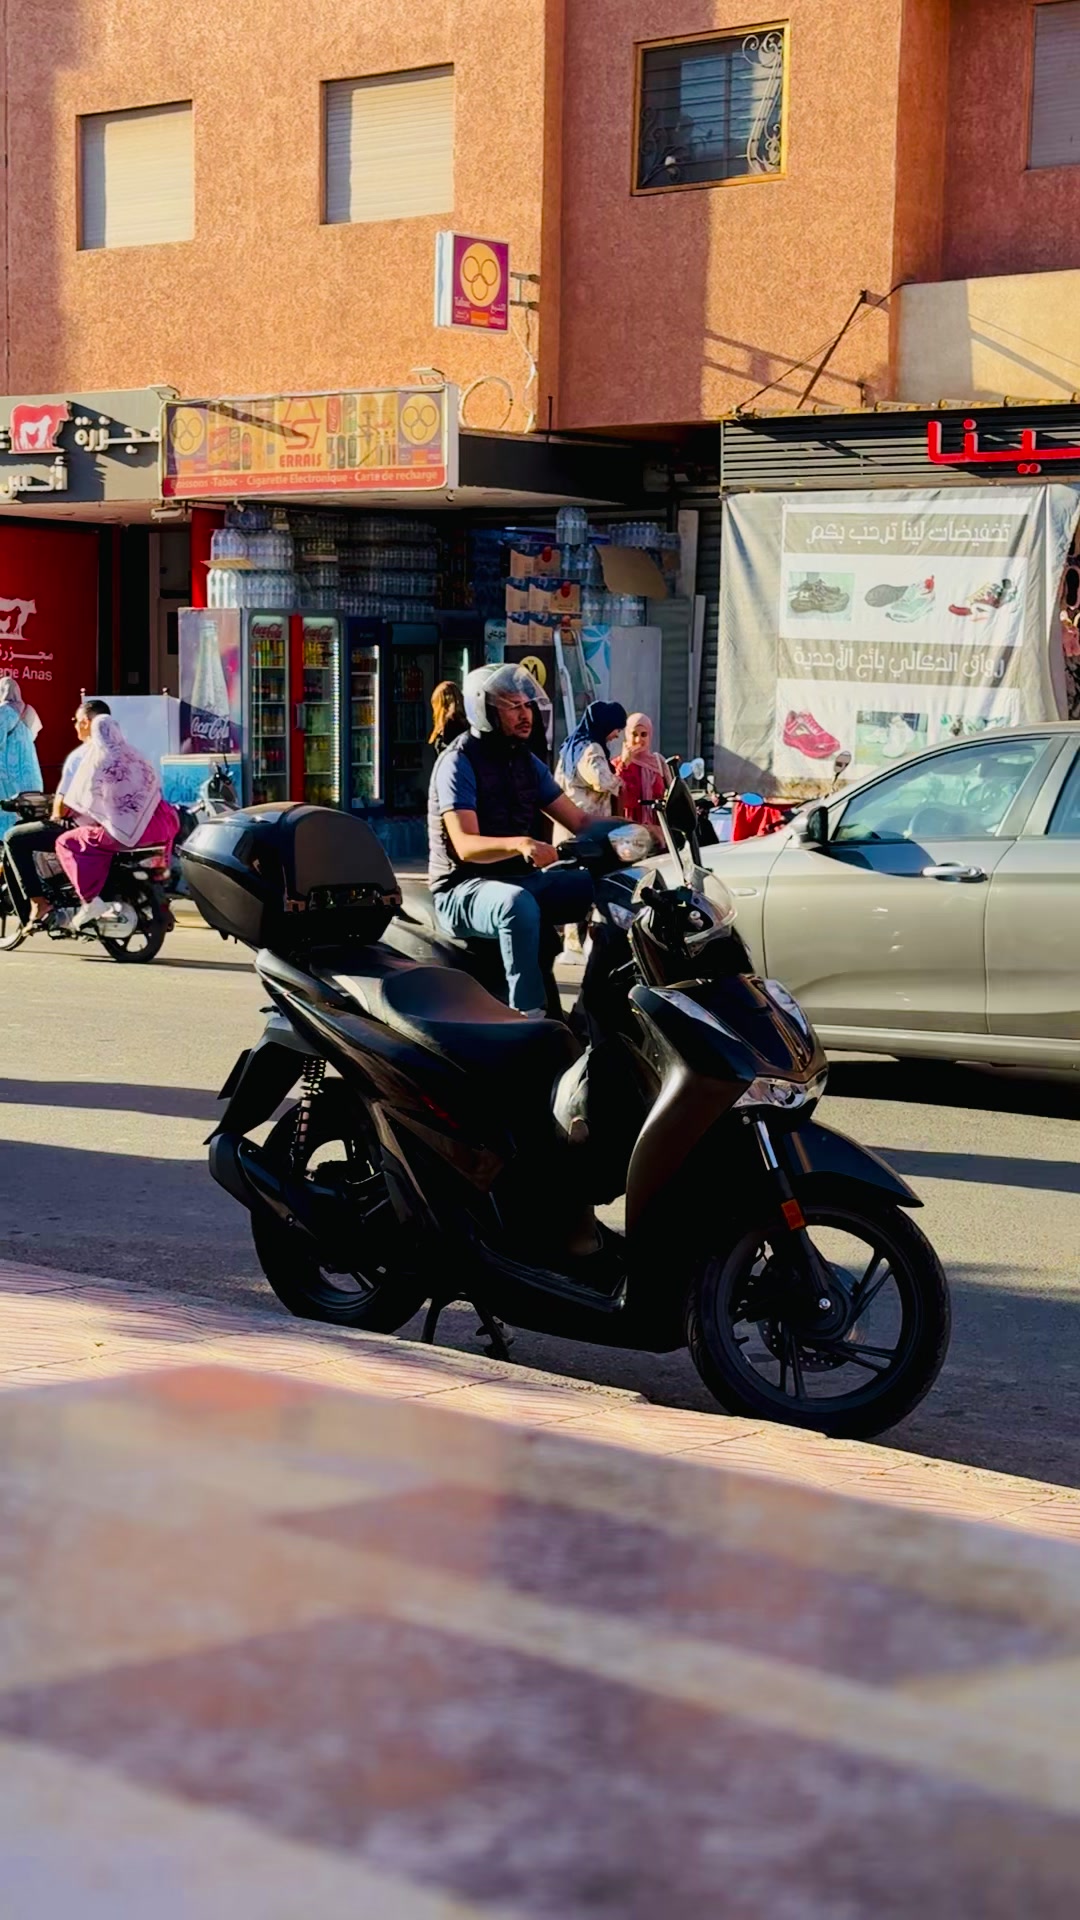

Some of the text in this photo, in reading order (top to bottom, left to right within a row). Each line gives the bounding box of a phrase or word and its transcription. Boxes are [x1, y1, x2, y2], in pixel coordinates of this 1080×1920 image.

[927, 418, 1080, 474] ينا
[279, 453, 322, 468] ERRAIS
[354, 471, 380, 481] Carte
[381, 471, 393, 481] de
[395, 469, 438, 482] recharge
[806, 520, 1011, 546] تخفيضات لينا ترحب بكم
[22, 665, 53, 681] Anas
[856, 647, 885, 678] بائع
[889, 650, 959, 678] الدكالي
[962, 652, 1005, 678] رواق
